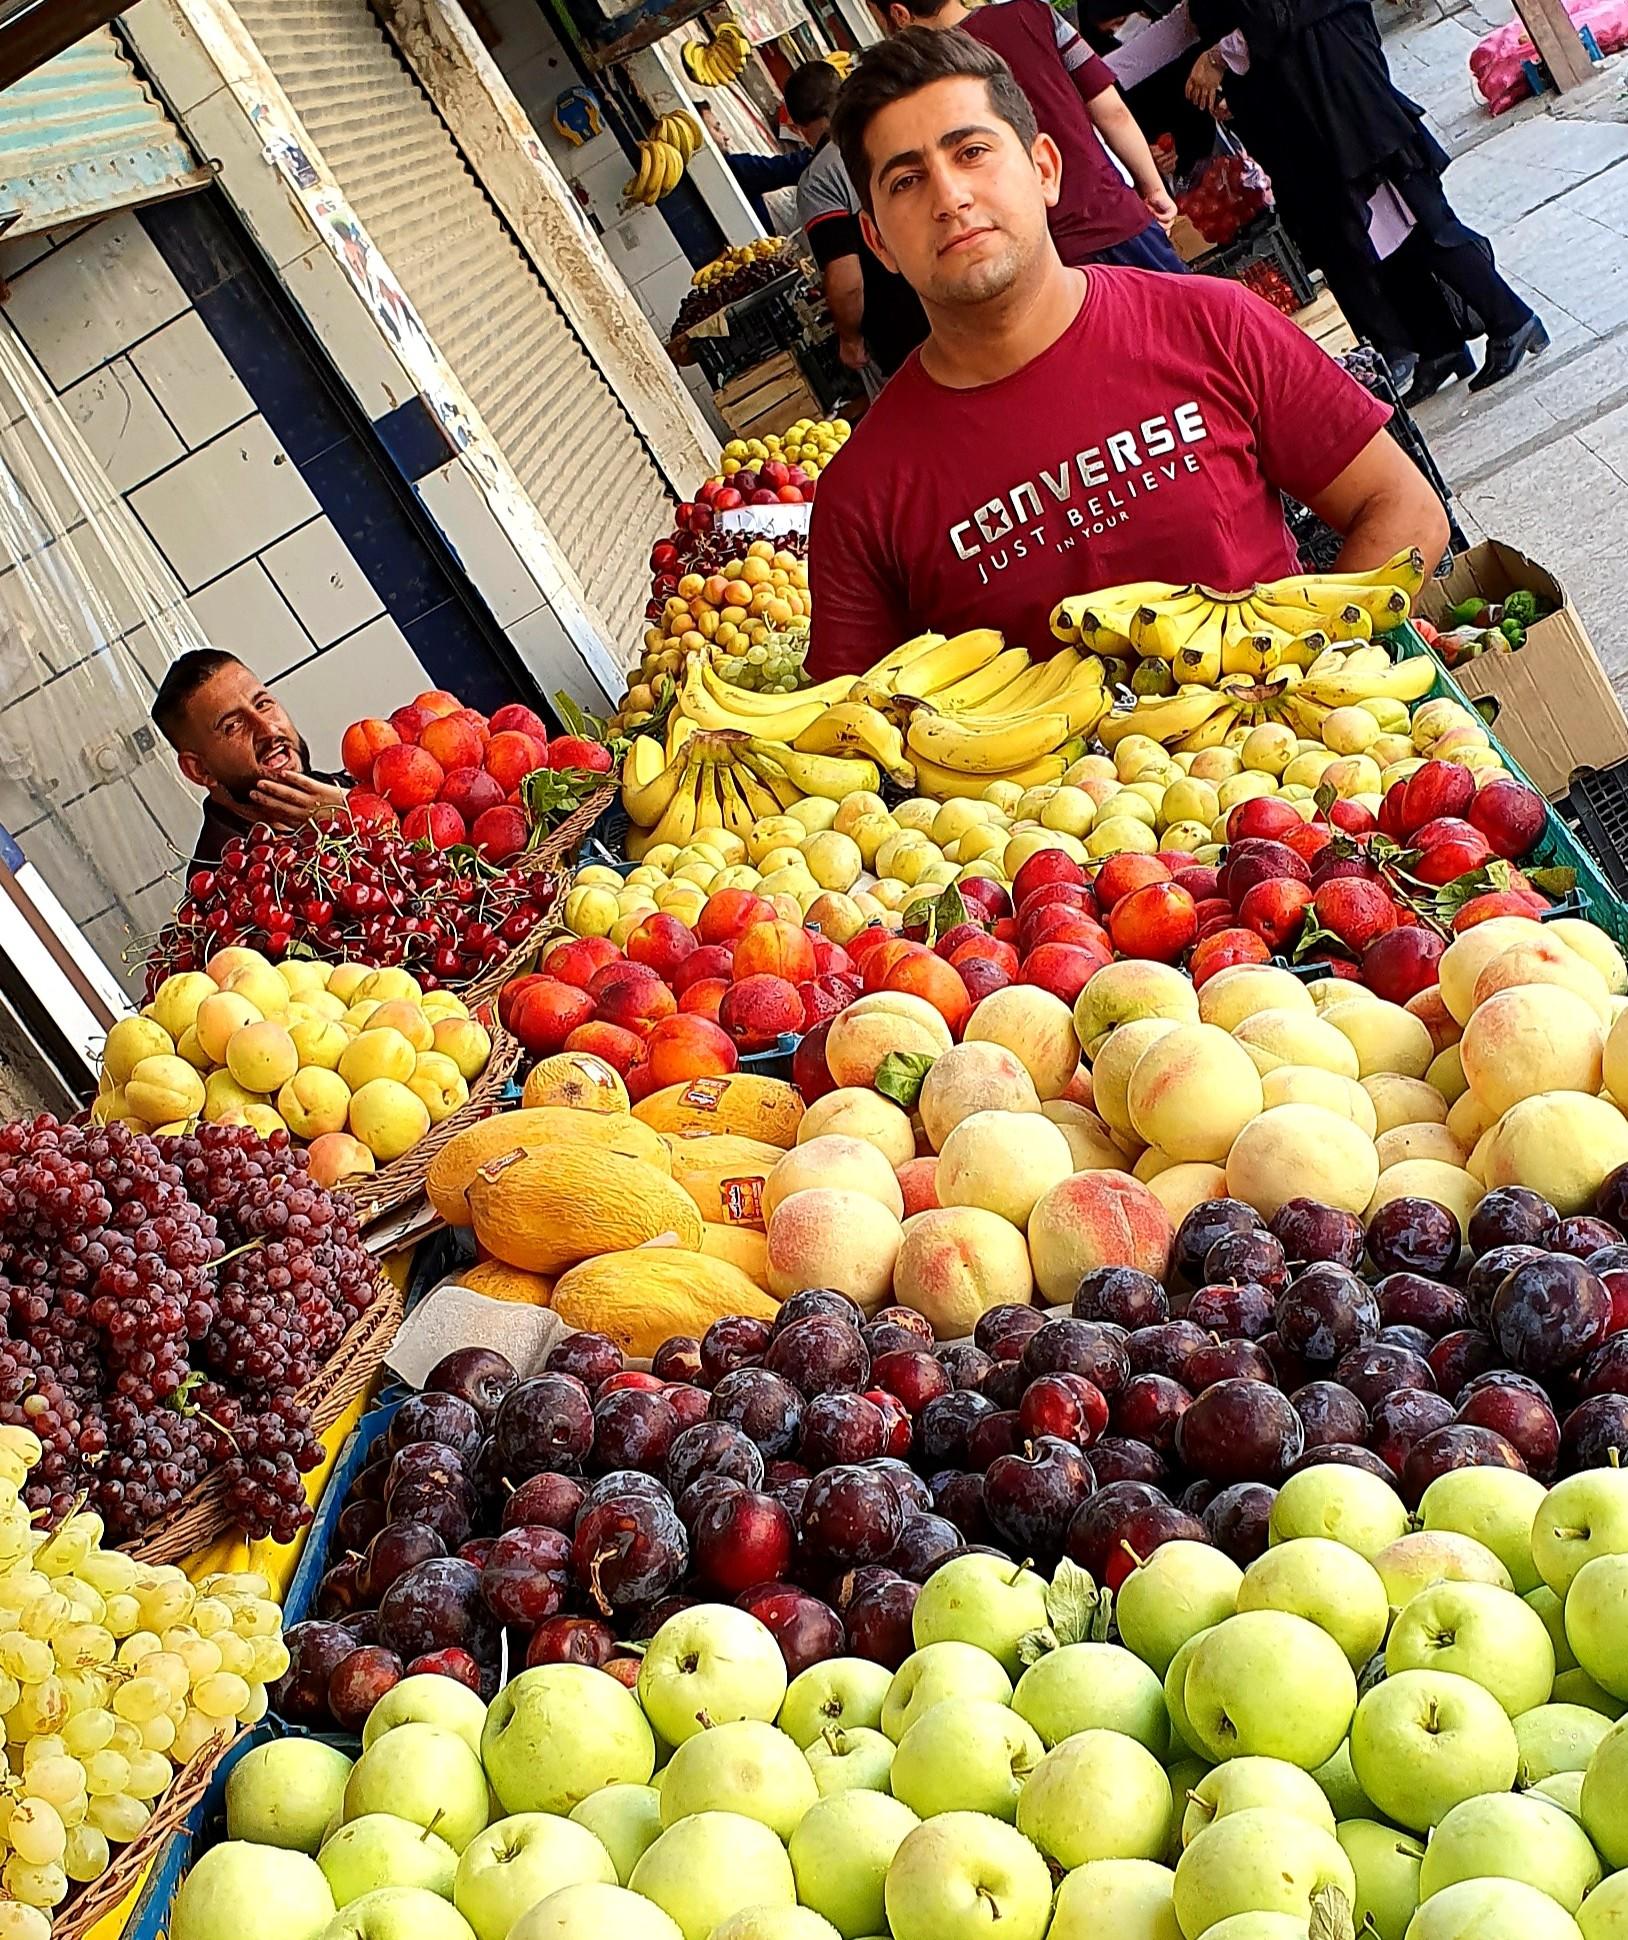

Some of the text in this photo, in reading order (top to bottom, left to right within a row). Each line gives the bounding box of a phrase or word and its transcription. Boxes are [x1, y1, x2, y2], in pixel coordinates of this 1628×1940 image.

[949, 401, 1208, 561] CONVERSE
[978, 453, 1200, 585] JUST BELIEVE
[1056, 511, 1130, 553] IN YOUR
